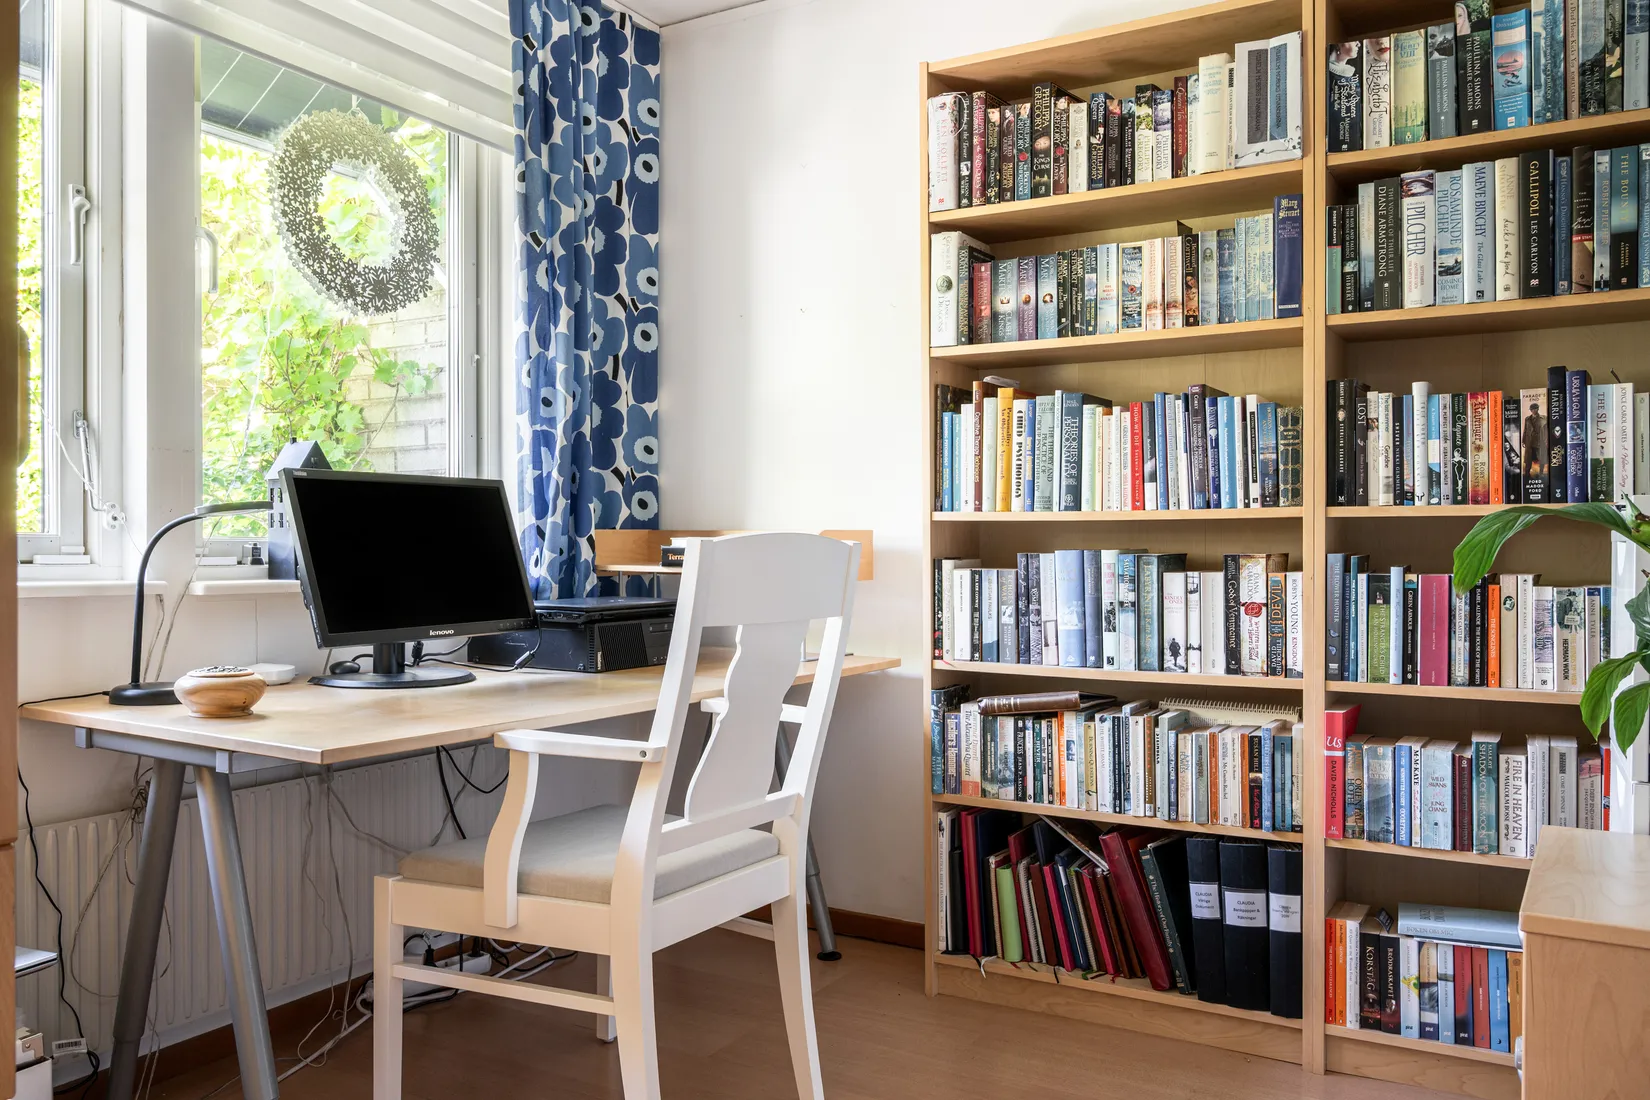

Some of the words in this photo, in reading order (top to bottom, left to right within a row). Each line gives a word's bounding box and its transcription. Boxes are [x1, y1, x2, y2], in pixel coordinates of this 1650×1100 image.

[1350, 75, 1359, 95] Mary
[1366, 62, 1390, 108] Elizabeth
[1034, 86, 1043, 131] GREGORY
[1043, 88, 1051, 127] PHILIPPA
[1091, 98, 1100, 119] Queen
[1348, 95, 1361, 117] Queen
[1621, 154, 1629, 176] THE
[1475, 167, 1487, 198] MAEVE
[1530, 161, 1540, 217] GALLIPOLI
[1378, 187, 1387, 215] DIANE
[1437, 189, 1449, 234] PILCHER
[1449, 176, 1462, 246] ROSAMUNDE
[1621, 180, 1629, 223] BOUNTY
[1389, 229, 1394, 237] OF
[1406, 205, 1427, 258] PILCHER
[1475, 200, 1487, 238] BINCHY
[1530, 221, 1538, 235] LES
[1378, 218, 1387, 277] ARMSTRONG
[1530, 237, 1539, 275] CARLYON
[1620, 387, 1628, 404] JOYCE
[1357, 403, 1367, 427] LOST
[1453, 415, 1468, 446] Elegance
[1471, 401, 1488, 443] Revenger
[1596, 412, 1606, 444] SLAP
[1070, 417, 1079, 459] THEORIES
[1071, 462, 1078, 477] OF
[1479, 462, 1487, 480] RORY
[1144, 564, 1152, 616] LABYRINTH
[1228, 580, 1238, 599] God
[1291, 578, 1299, 601] ROBYN
[1226, 607, 1238, 648] Vengeance
[1291, 601, 1299, 634] YOUNG
[964, 710, 972, 720] The
[964, 721, 973, 753] Alexandria
[964, 754, 972, 778] Quartet
[1479, 744, 1487, 781] SHADOW
[1512, 760, 1523, 781] FIRE
[1479, 782, 1487, 793] OF
[1512, 784, 1522, 796] IN
[1479, 812, 1487, 839] MOON
[1512, 797, 1523, 841] HEAVEN
[1366, 946, 1376, 991] KORSTÅG
[1387, 947, 1395, 998] BRÖDRASKAPET
